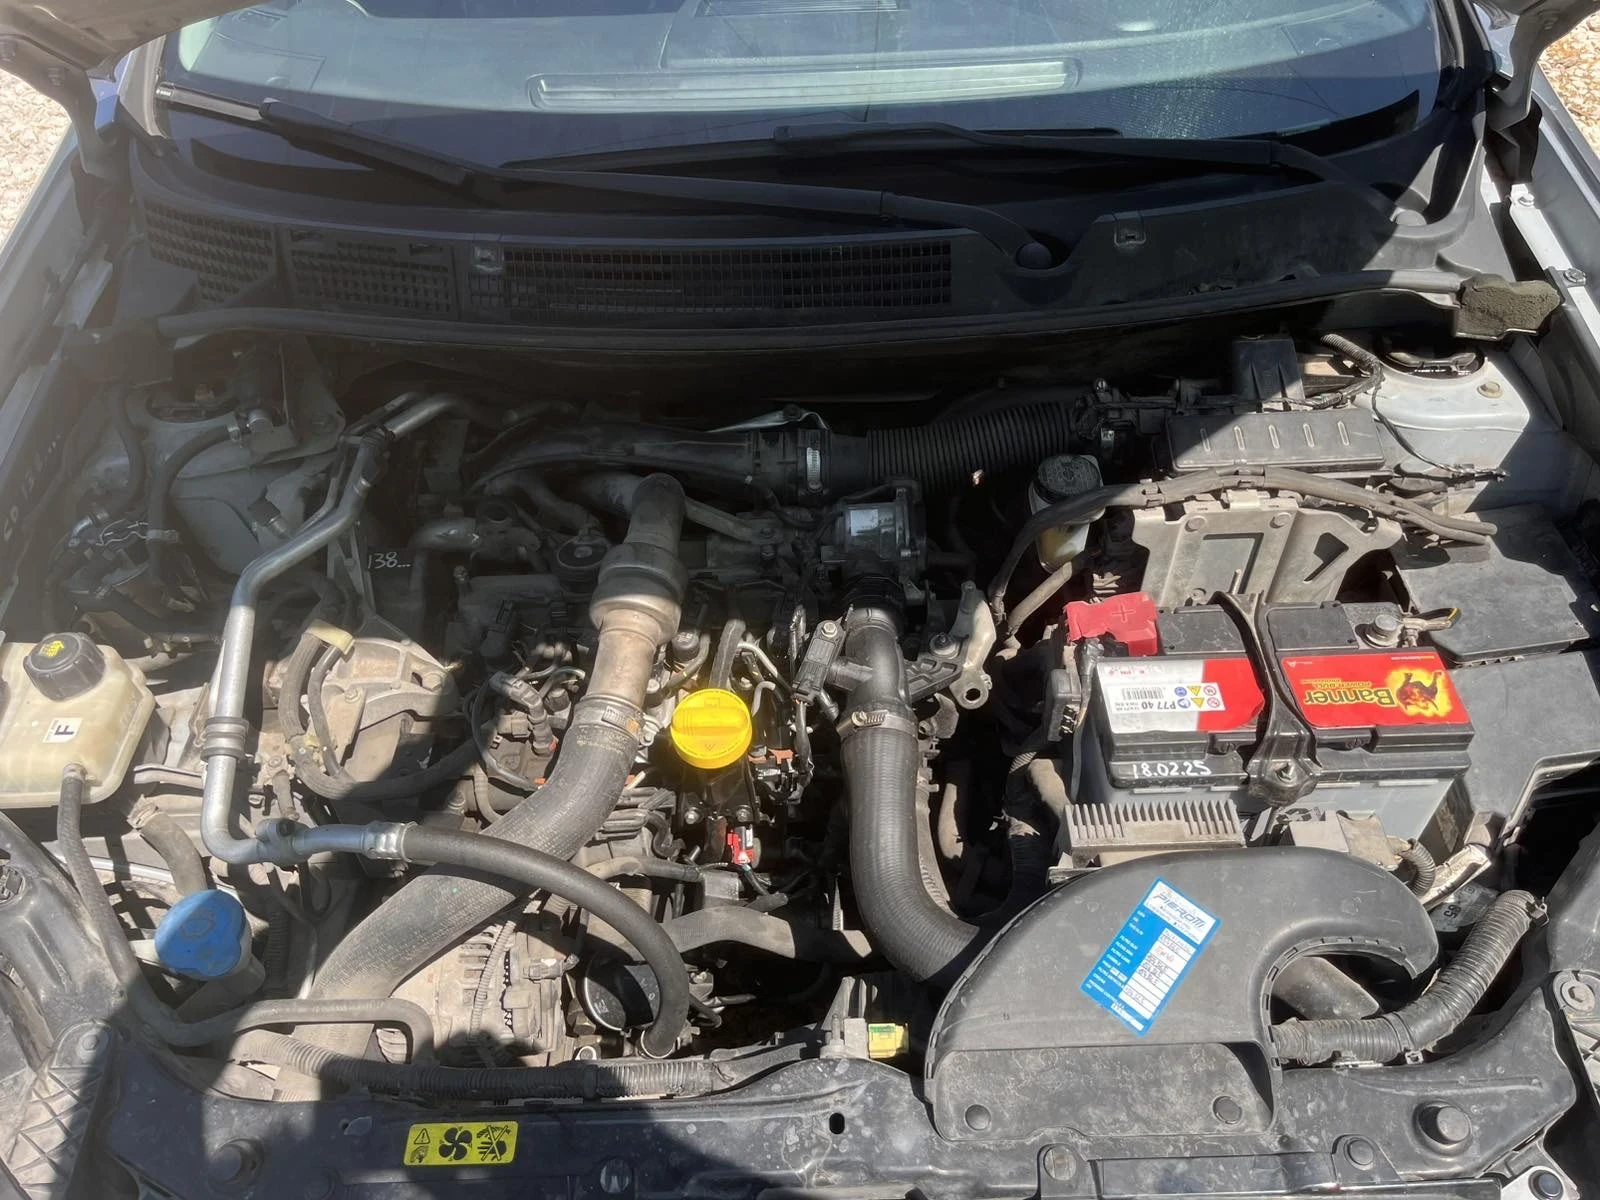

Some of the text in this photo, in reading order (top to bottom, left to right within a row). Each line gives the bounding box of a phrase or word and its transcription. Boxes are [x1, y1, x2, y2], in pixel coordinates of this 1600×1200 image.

[1305, 688, 1396, 706] Banner
[1141, 701, 1154, 710] 40
[1157, 701, 1177, 710] P77
[1132, 760, 1211, 779] 18.02.25
